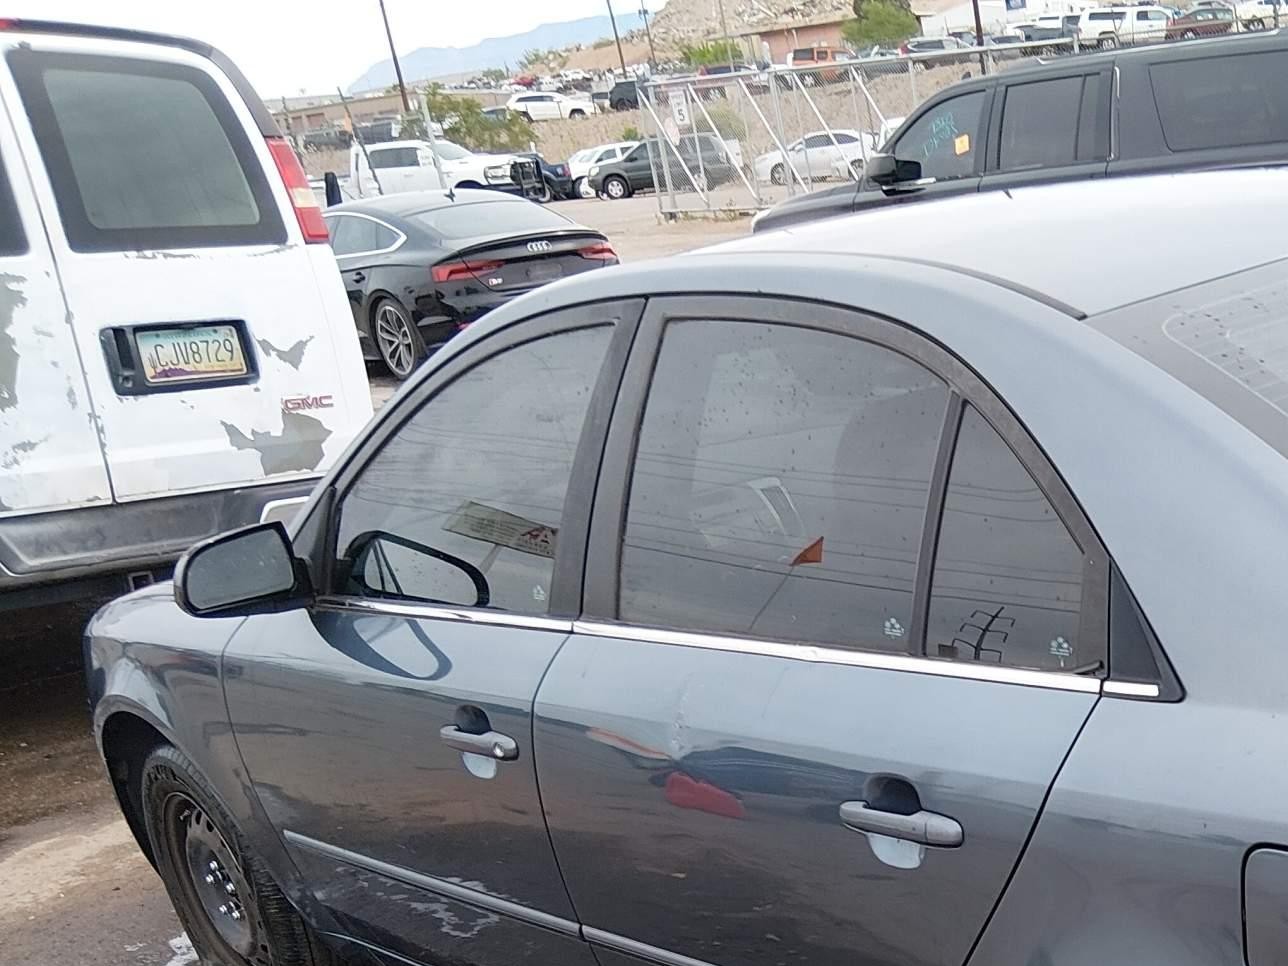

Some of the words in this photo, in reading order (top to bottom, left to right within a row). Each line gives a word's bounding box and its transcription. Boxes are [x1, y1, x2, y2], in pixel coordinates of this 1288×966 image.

[678, 108, 685, 122] 5
[153, 338, 235, 367] CJV8729
[284, 395, 334, 411] GMC
